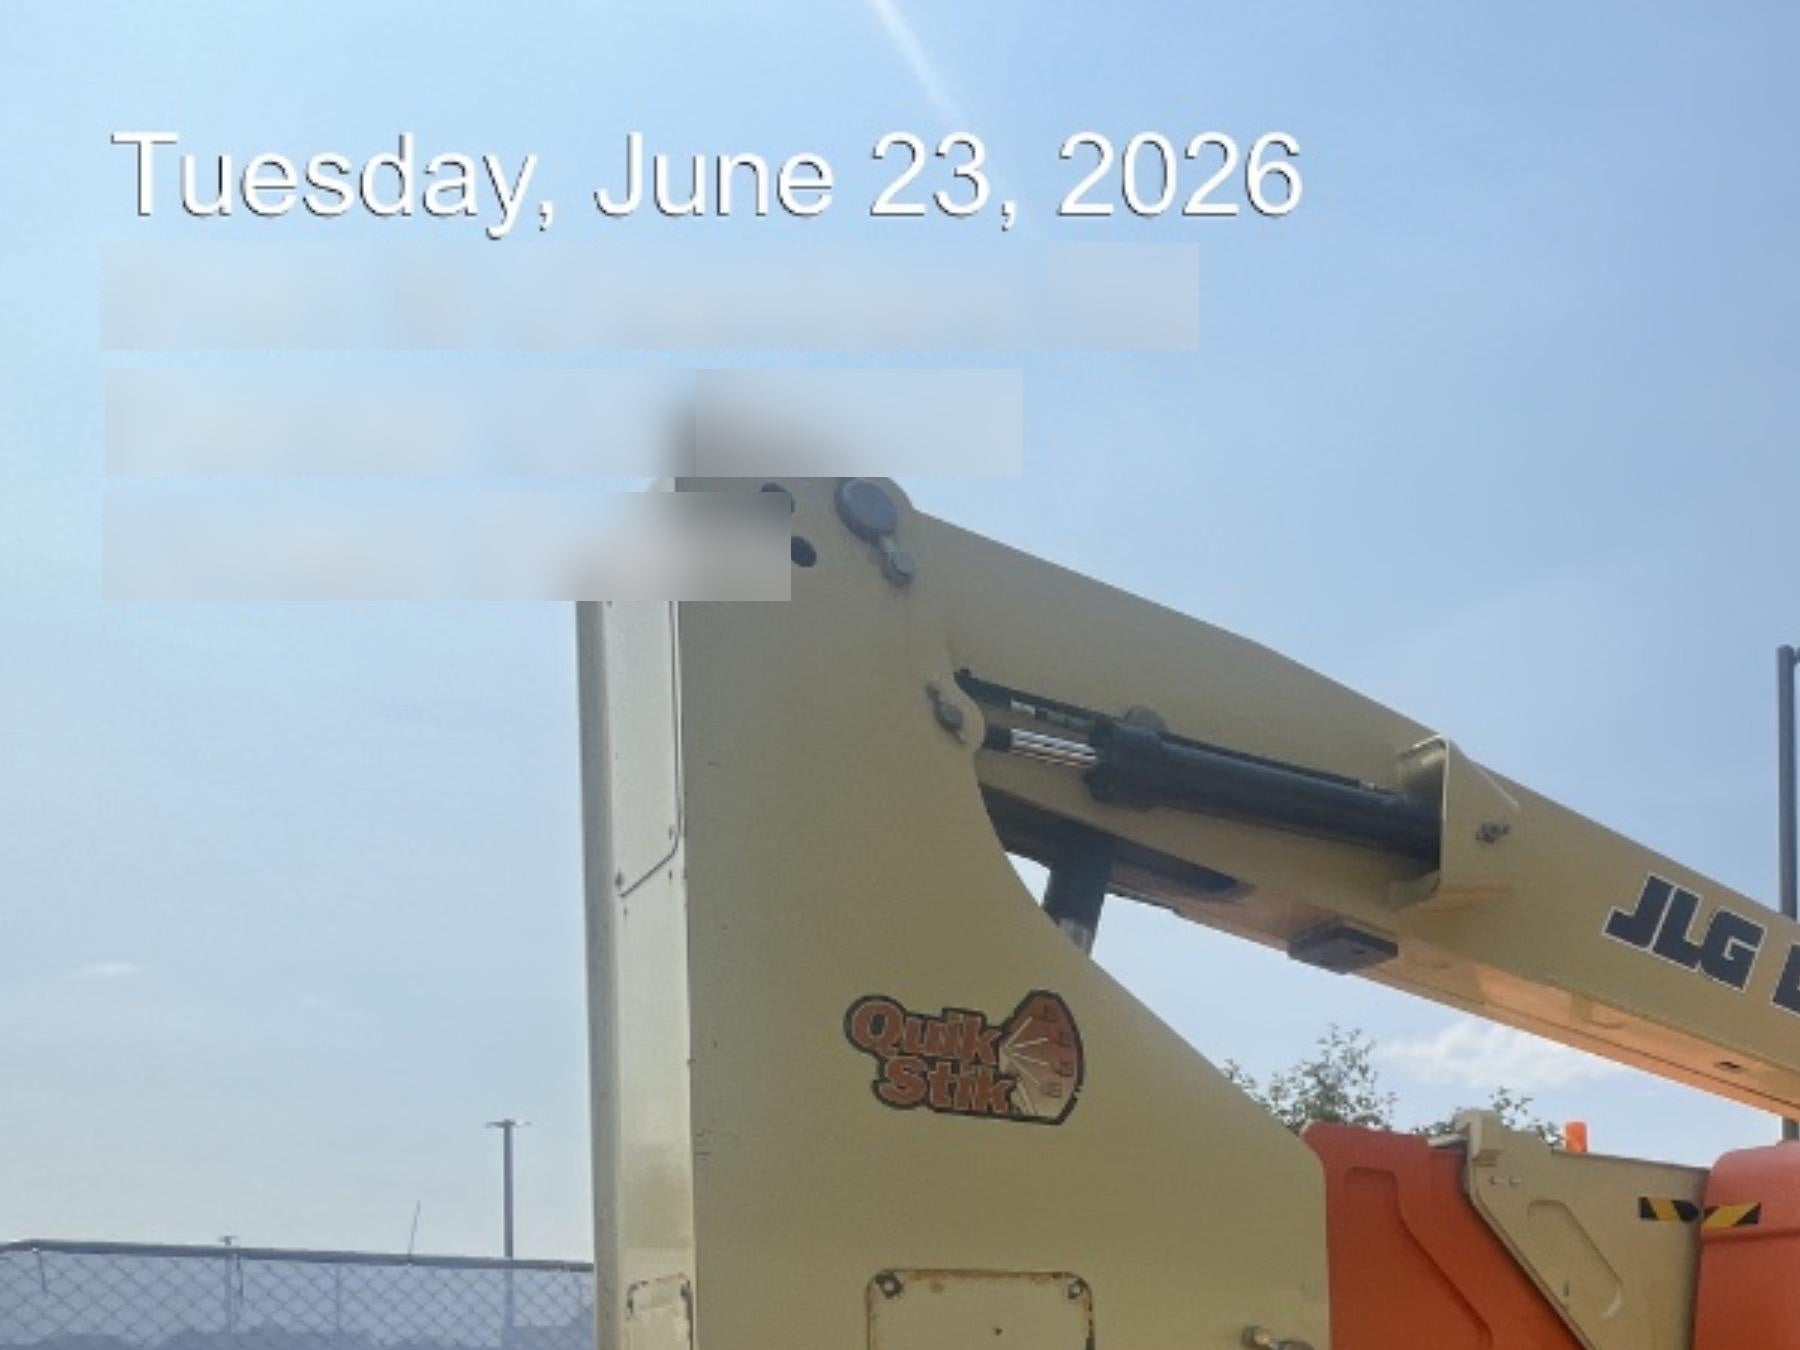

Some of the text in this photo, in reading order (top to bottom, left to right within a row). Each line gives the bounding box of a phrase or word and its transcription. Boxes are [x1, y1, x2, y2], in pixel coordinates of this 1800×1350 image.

[1603, 873, 1767, 992] JLG
[852, 1000, 1002, 1066] Quik
[879, 1055, 1015, 1114] Stik
